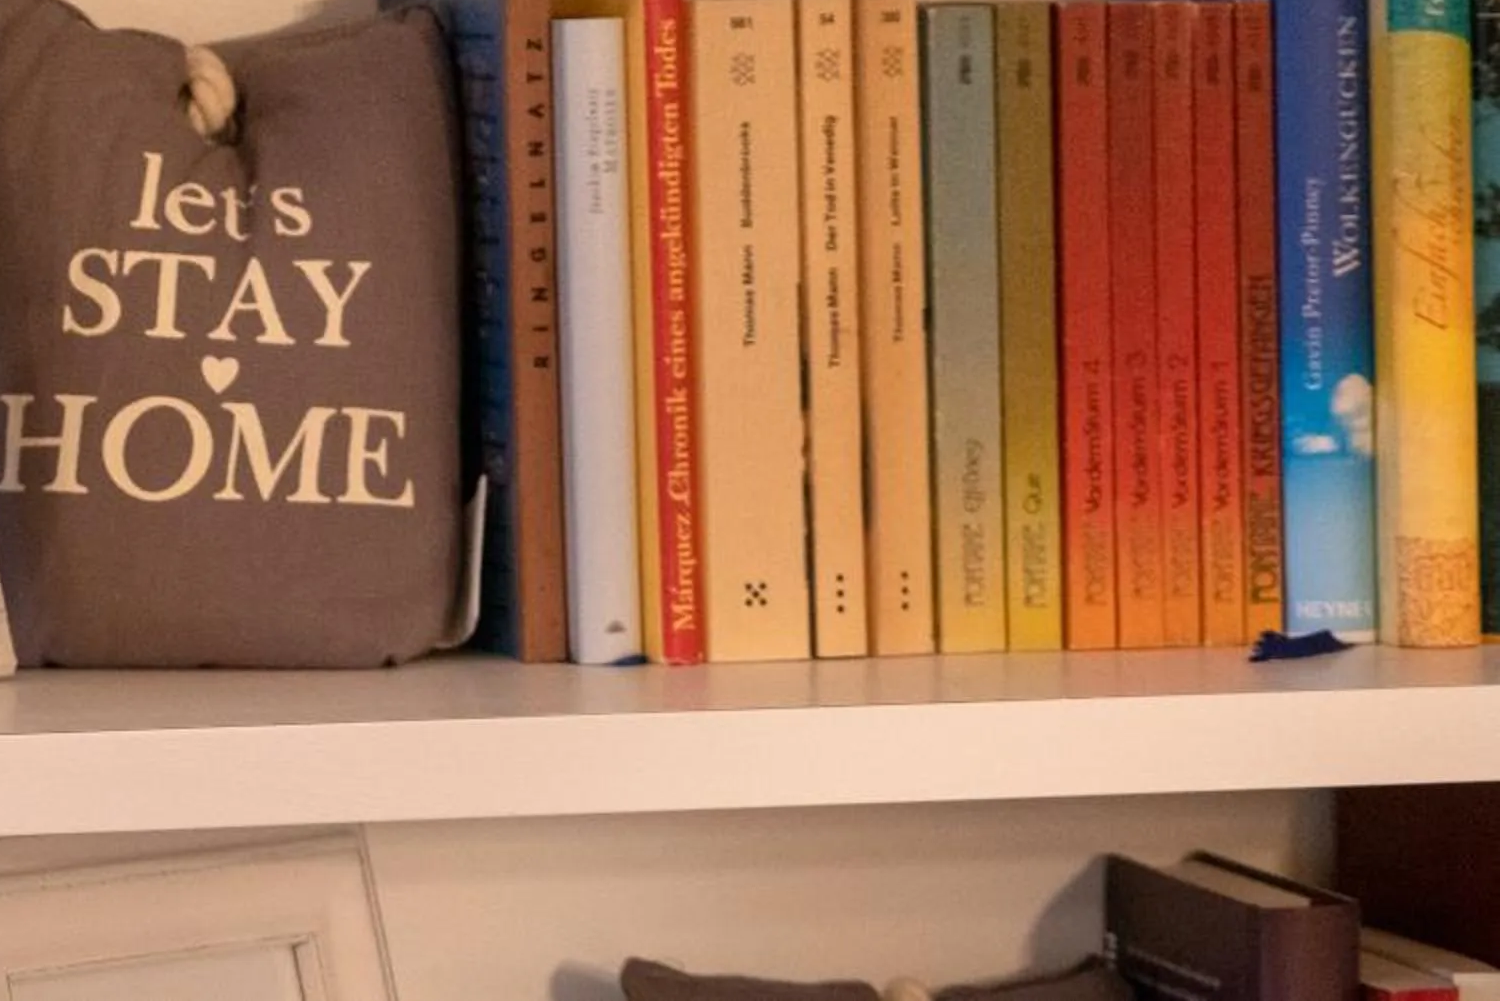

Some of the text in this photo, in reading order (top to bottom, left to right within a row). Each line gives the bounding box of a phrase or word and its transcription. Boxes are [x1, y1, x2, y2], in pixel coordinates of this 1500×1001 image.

[525, 37, 550, 369] RINGELNATZ
[653, 18, 692, 504] Chronik eines angekündigten Todes
[738, 121, 757, 347] Thomas Mann Buddenbrooks
[822, 114, 841, 368] Thomas Mann Der Tod Venedig
[1331, 15, 1363, 277] WOLKENGUCKEN
[62, 248, 372, 347] STAY
[1300, 175, 1325, 391] Gavin Pretor-Pinney
